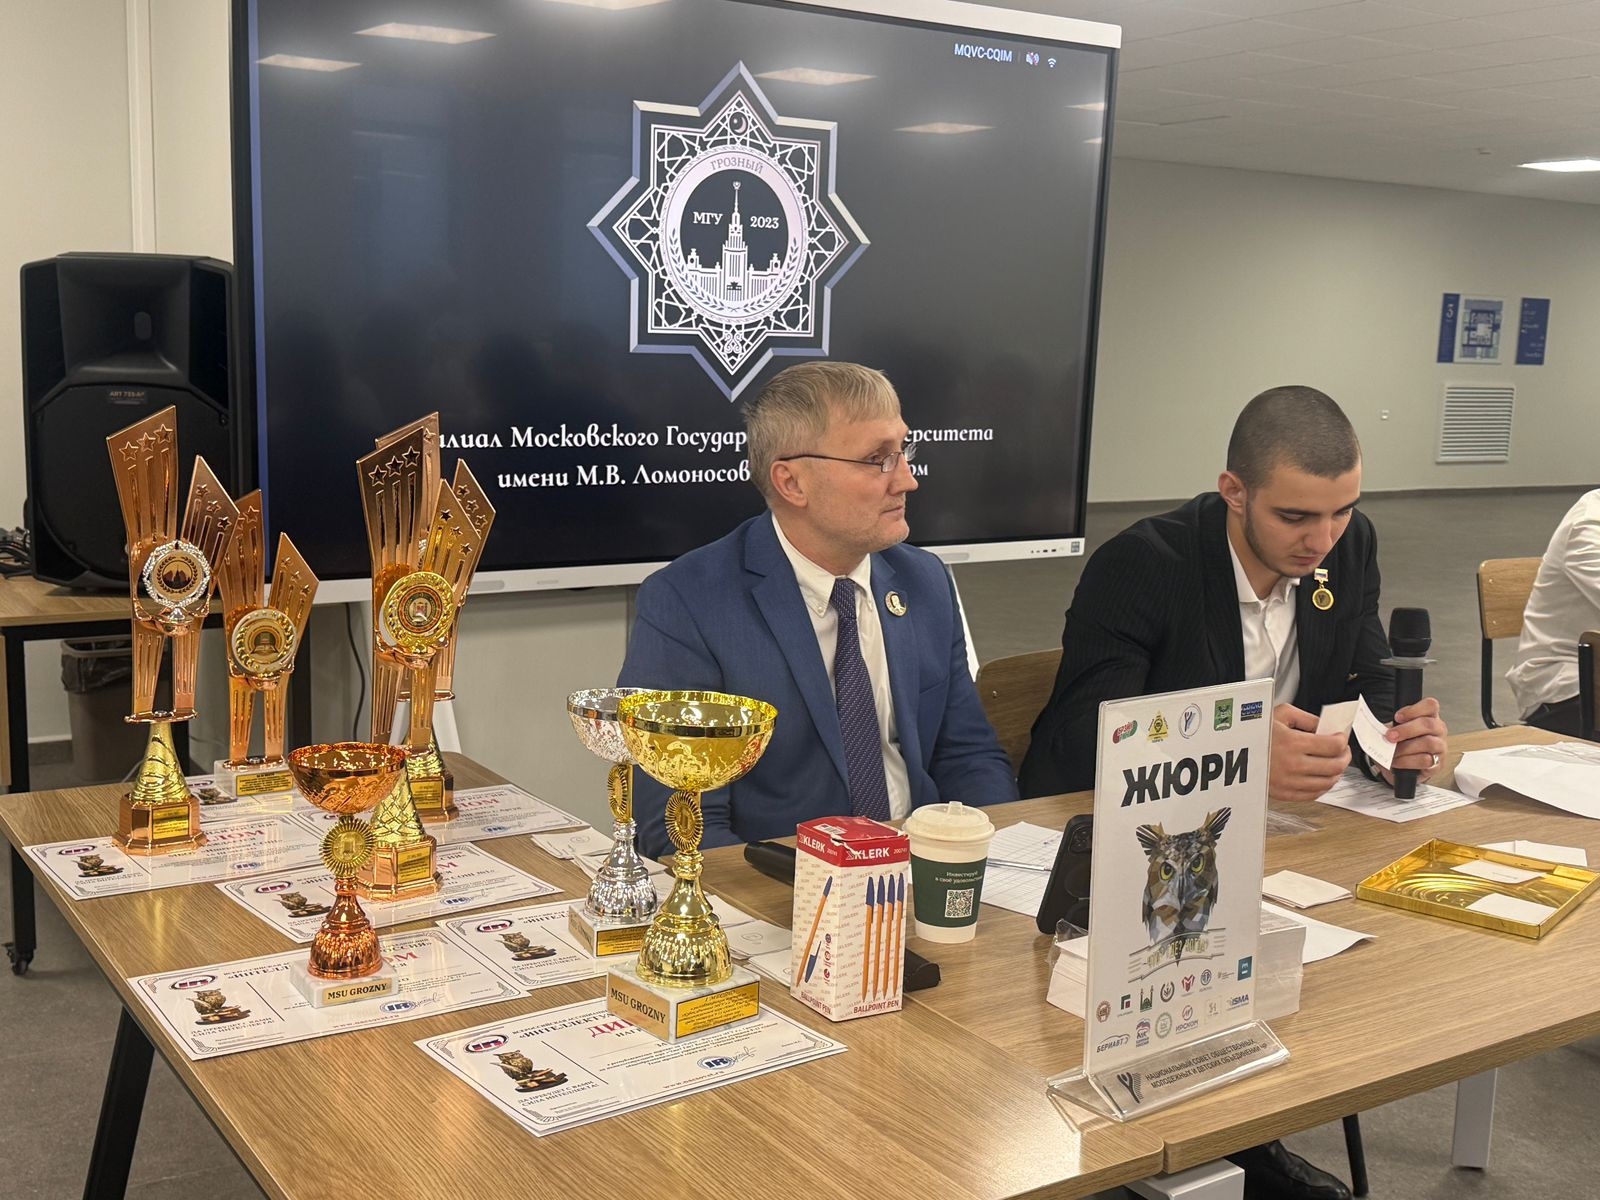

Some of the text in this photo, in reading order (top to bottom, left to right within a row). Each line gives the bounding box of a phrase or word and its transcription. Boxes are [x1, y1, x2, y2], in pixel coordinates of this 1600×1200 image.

[954, 43, 1013, 62] MQVC-CQIM
[711, 156, 764, 174] ГРОЗНЫЙ
[693, 211, 723, 225] МГУ
[750, 216, 780, 229] 2023
[440, 423, 994, 453] илиал Московского Государ ерситета
[497, 459, 751, 488] имени М.В. Ломоносов
[1120, 747, 1249, 808] ЖЮРИ
[803, 836, 826, 854] KLERK
[854, 847, 890, 860] KLERK
[327, 989, 349, 1000] MSU
[349, 983, 388, 996] GROZNY
[610, 986, 629, 1005] MSU
[630, 1000, 666, 1024] GROZNY
[853, 1000, 899, 1014] BALLPOINT PEN
[1191, 1053, 1211, 1066] СОВЕТ
